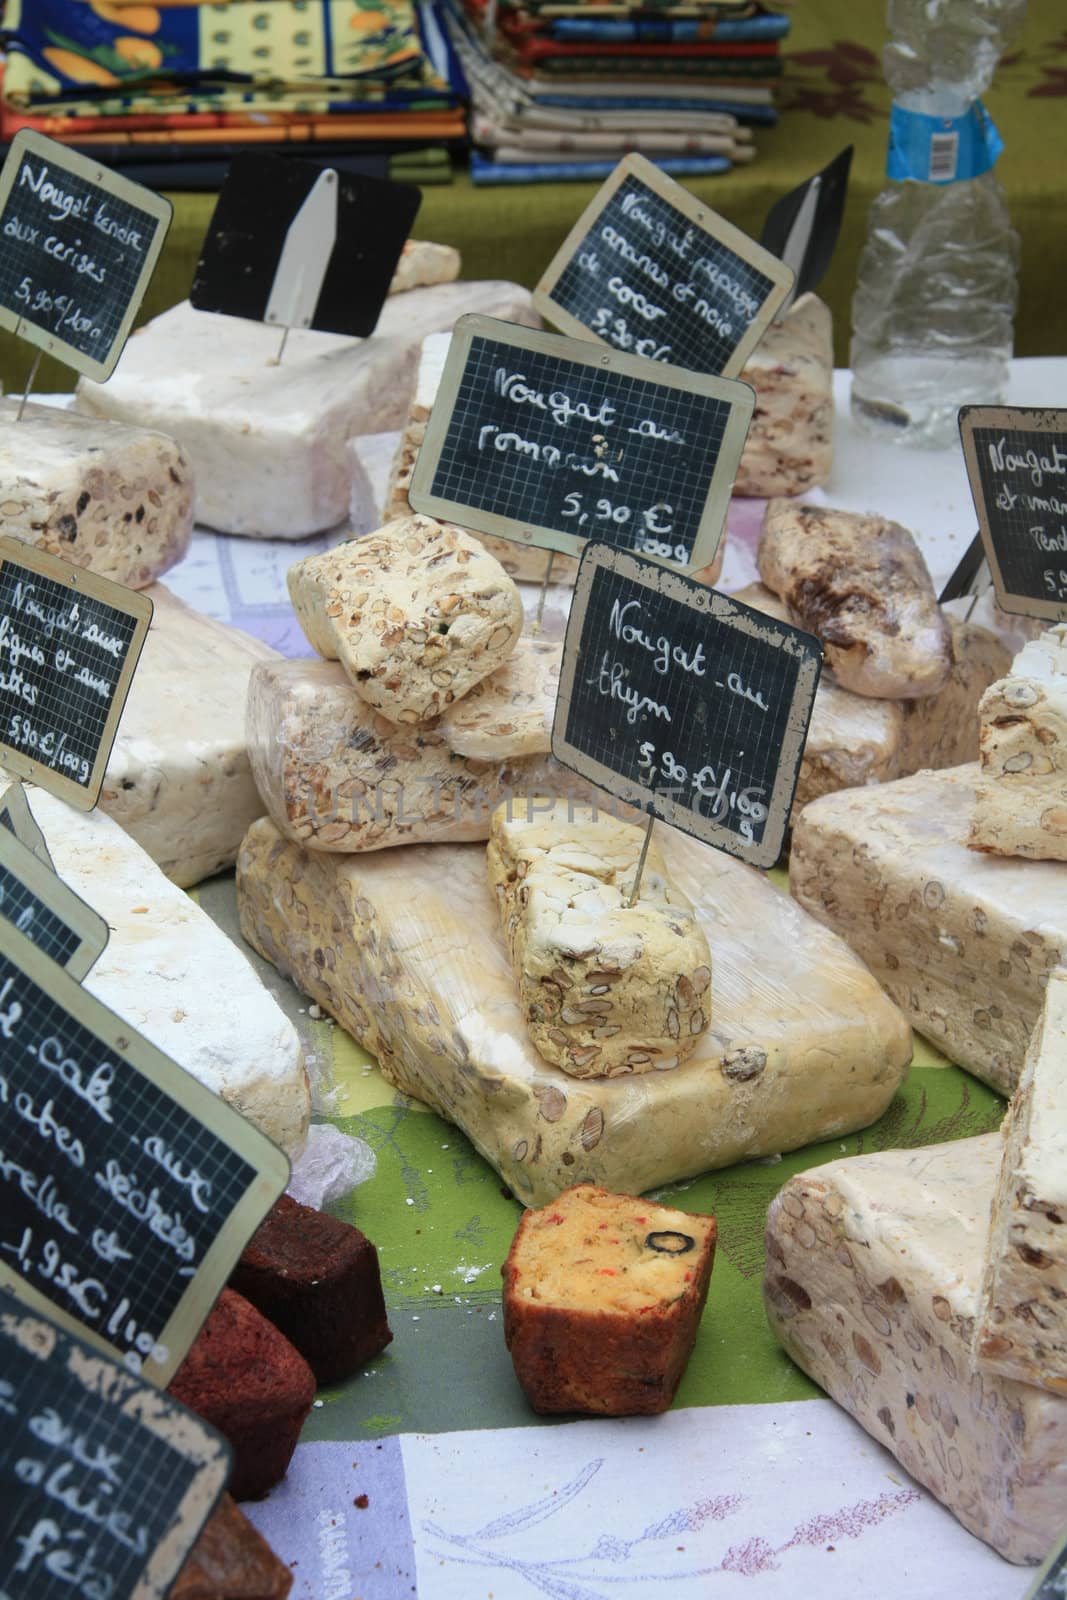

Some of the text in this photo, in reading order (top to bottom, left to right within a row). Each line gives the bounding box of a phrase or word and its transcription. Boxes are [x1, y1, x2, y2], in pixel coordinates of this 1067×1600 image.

[19, 164, 91, 221] Nougat
[4, 216, 105, 283] aux cerises
[621, 192, 694, 258] Nougat
[602, 226, 669, 289] ananas
[608, 276, 666, 320] coco
[495, 367, 686, 444] Nougat au
[989, 437, 1067, 487] Nougat
[11, 582, 79, 637] Nougat
[55, 649, 76, 672] et
[609, 599, 769, 712] Nougat au
[0, 668, 38, 706] attes
[586, 651, 672, 724] thym
[92, 1229, 132, 1263] et
